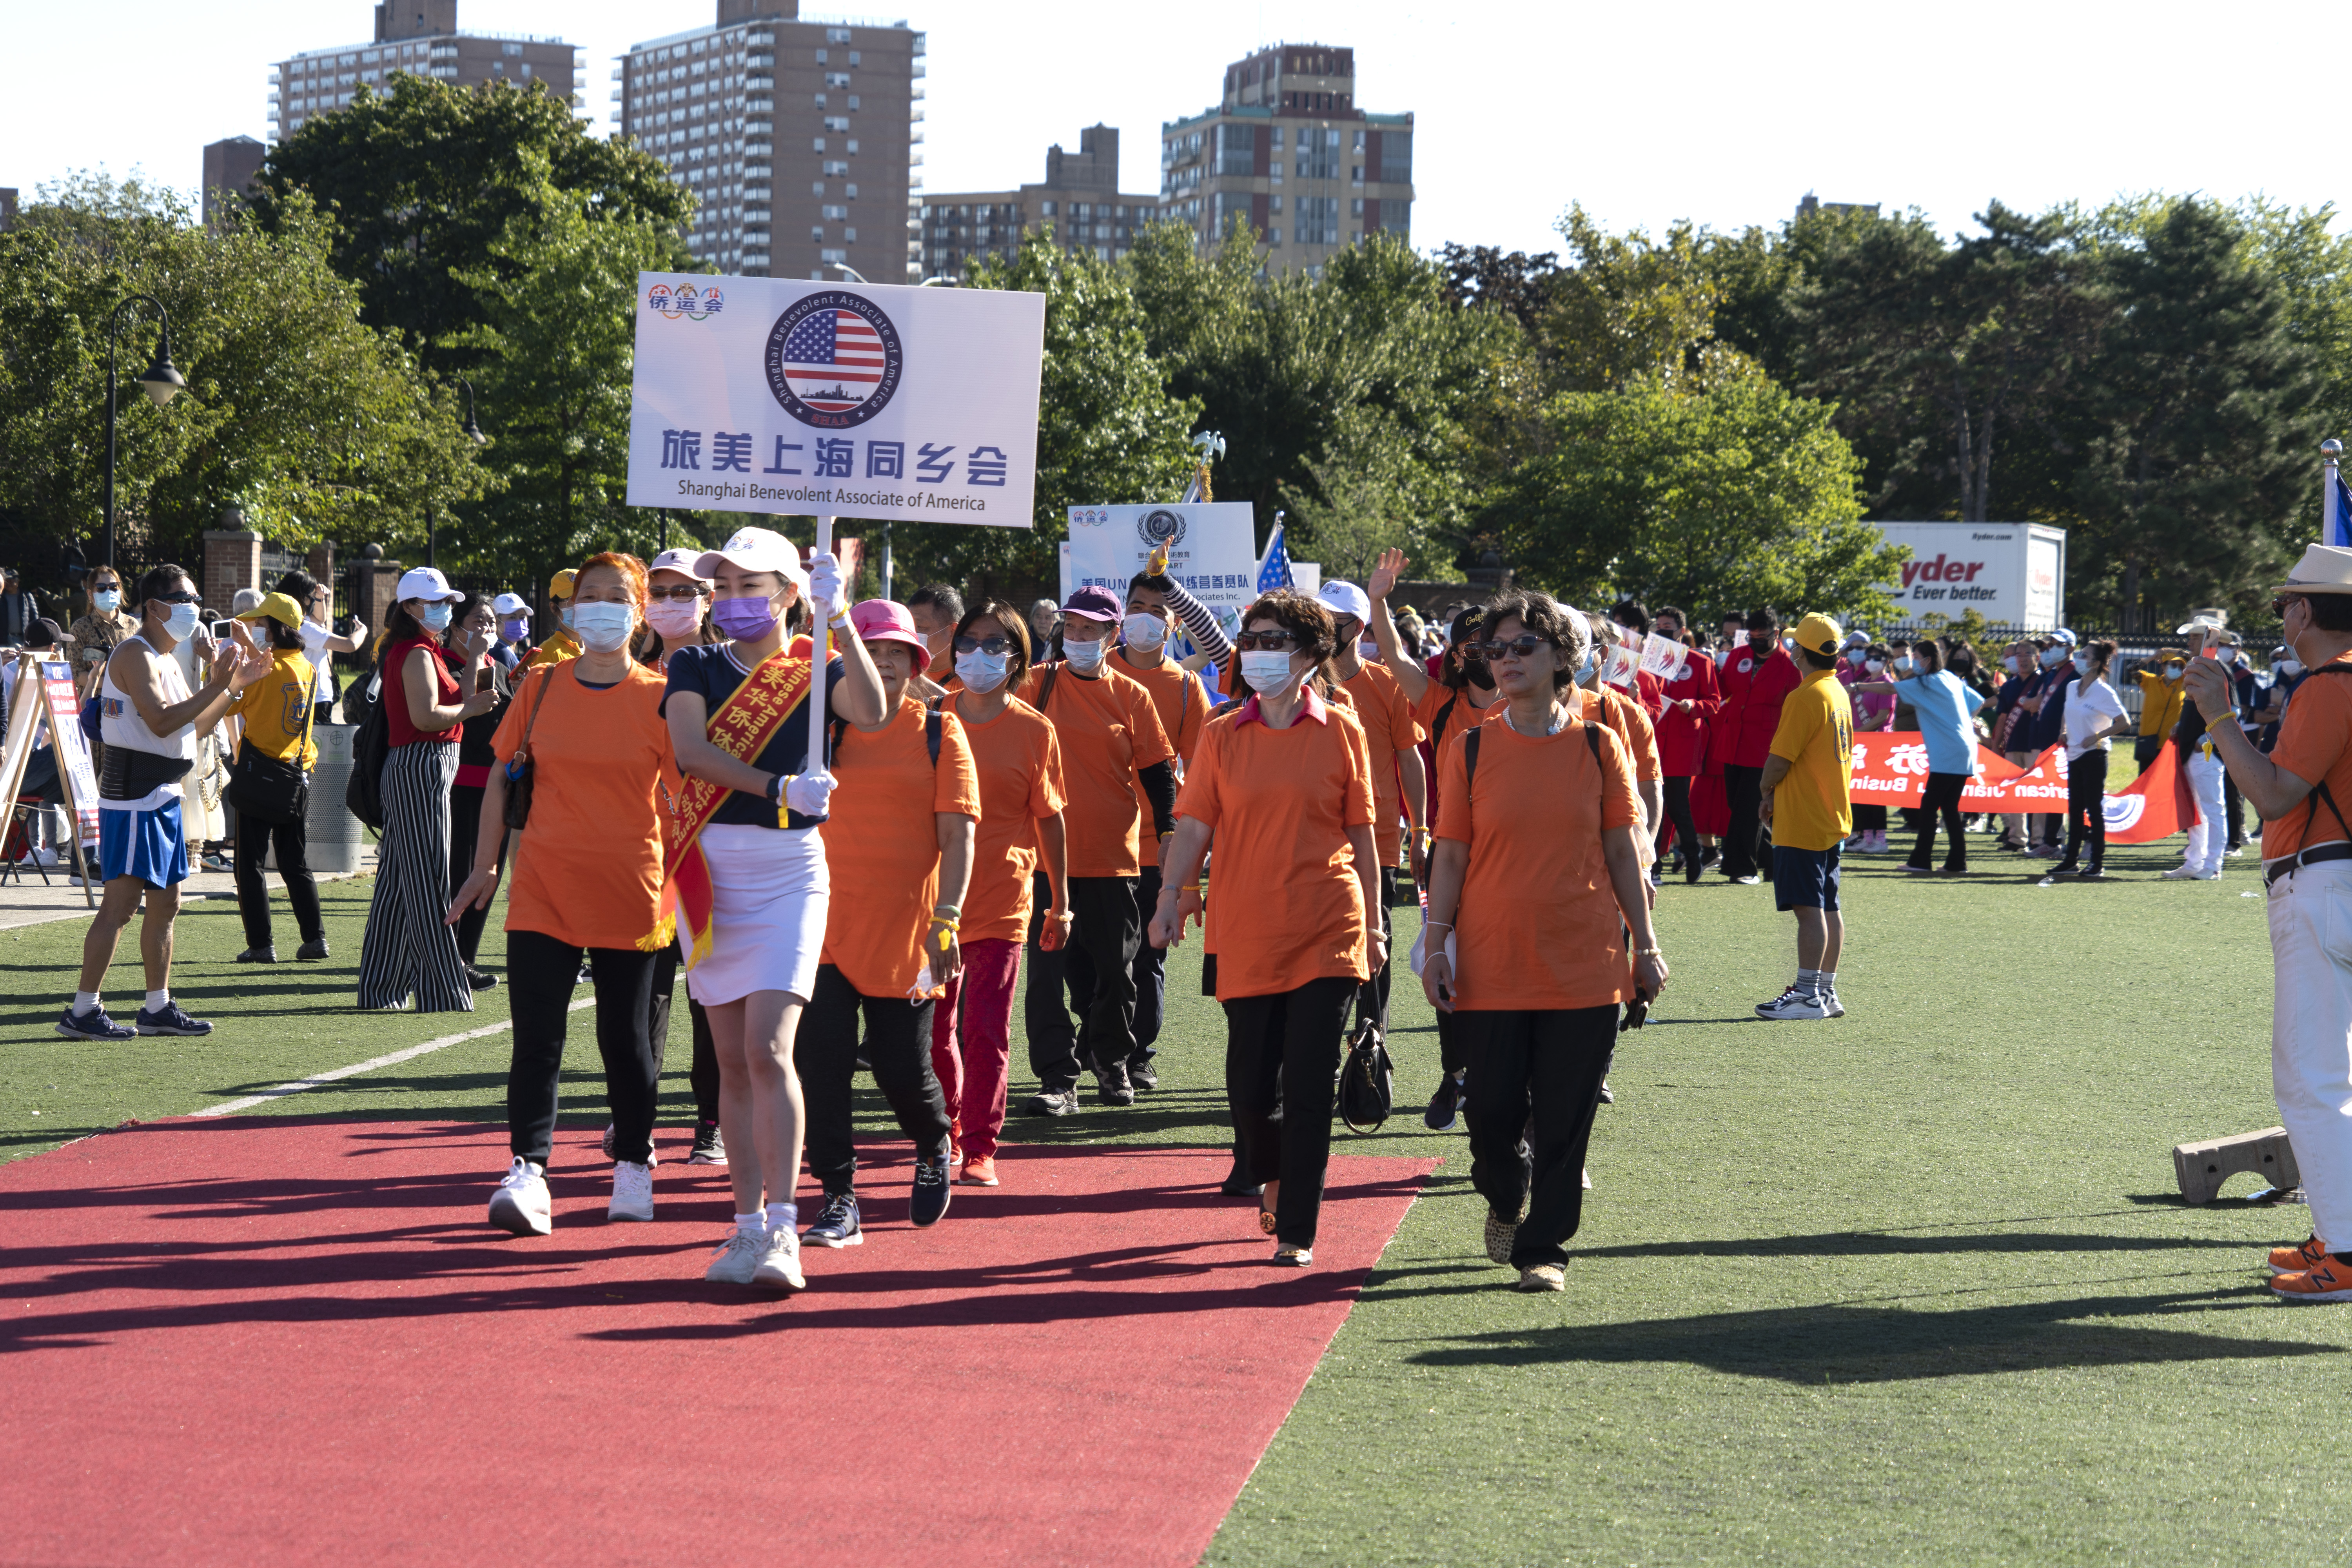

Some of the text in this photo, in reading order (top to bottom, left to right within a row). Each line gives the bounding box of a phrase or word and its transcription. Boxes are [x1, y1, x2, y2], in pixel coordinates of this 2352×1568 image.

[649, 296, 723, 312] 侨运会
[769, 295, 898, 408] Shanghai Benevolent Associate of America
[811, 414, 849, 426] SHAA
[661, 429, 1007, 486] 旅美上海同乡会
[678, 479, 985, 511] Shanghai Benevolent Associate of America
[1901, 553, 1984, 588] yder
[1913, 585, 1996, 600] Ever better.
[673, 660, 813, 849] Chinese America orts Game
